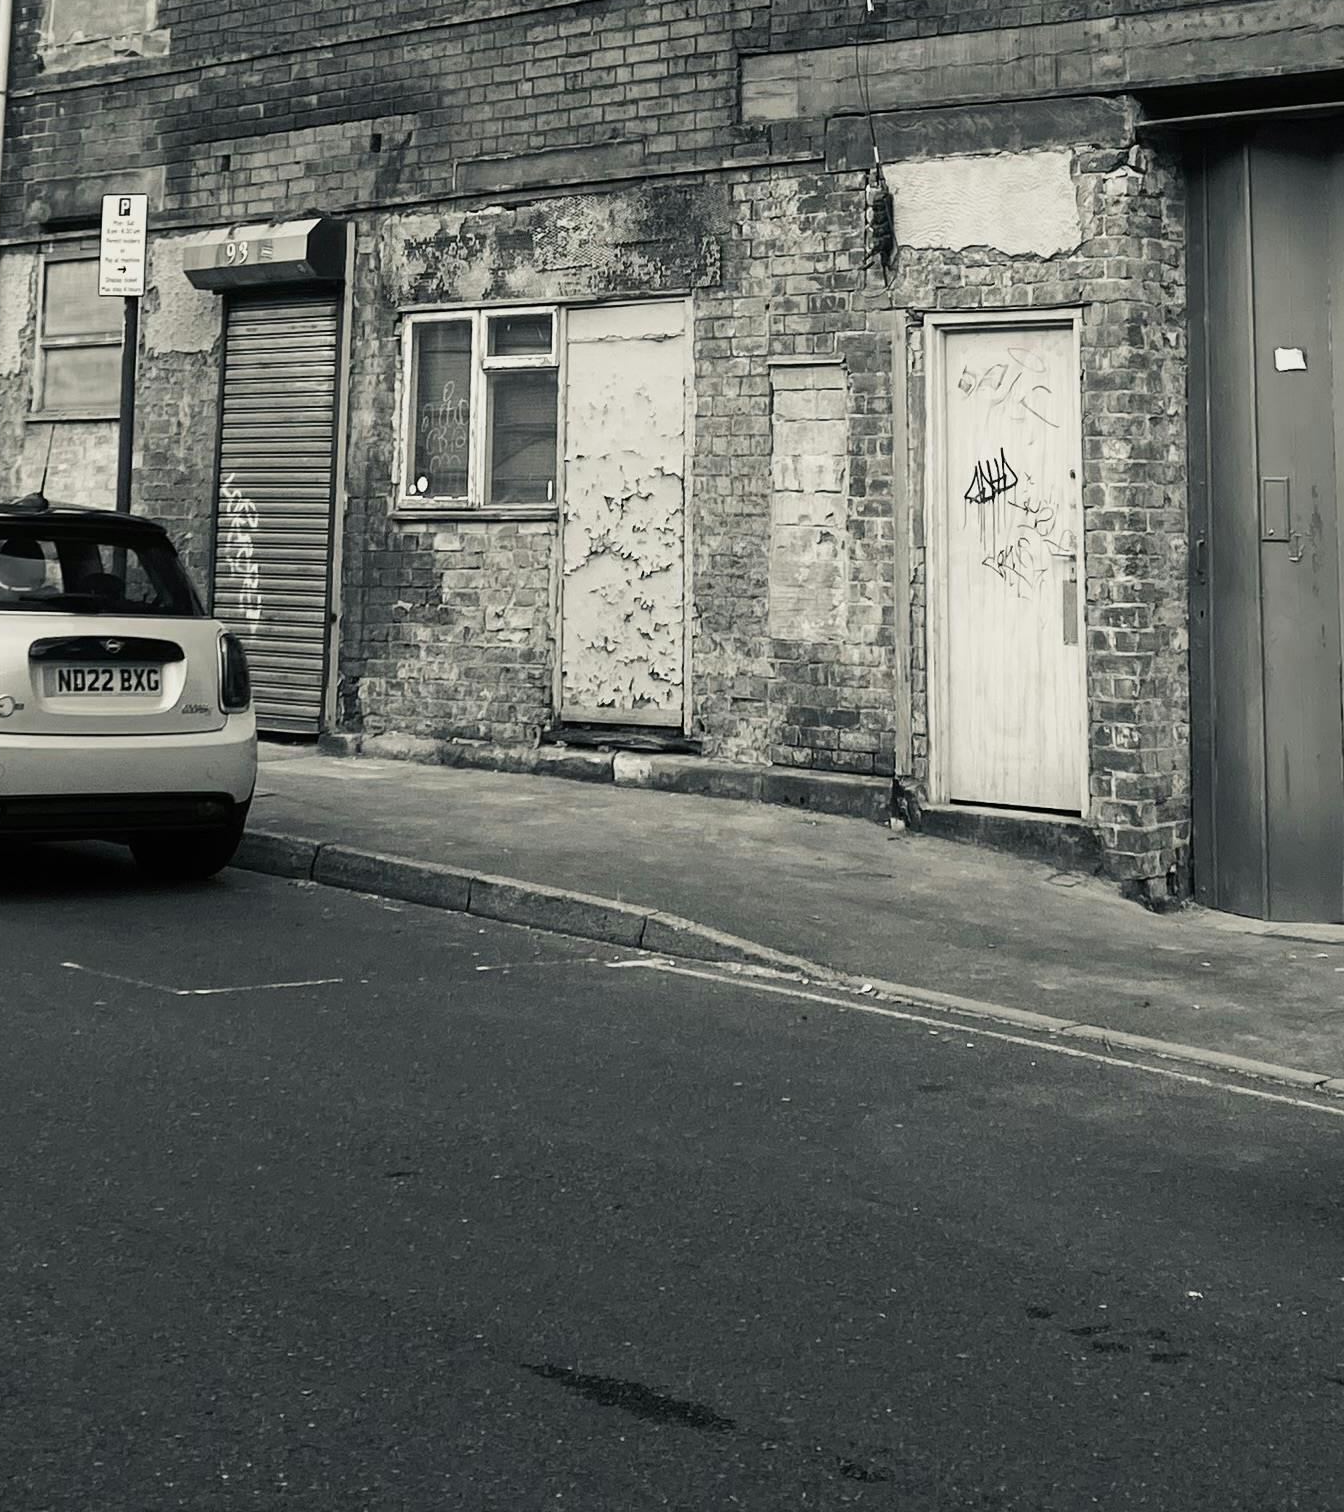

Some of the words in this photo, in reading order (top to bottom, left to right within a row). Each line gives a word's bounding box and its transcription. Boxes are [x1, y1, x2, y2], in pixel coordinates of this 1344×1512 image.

[226, 241, 248, 265] 93
[58, 669, 114, 692] ND22
[120, 668, 160, 692] BXG
